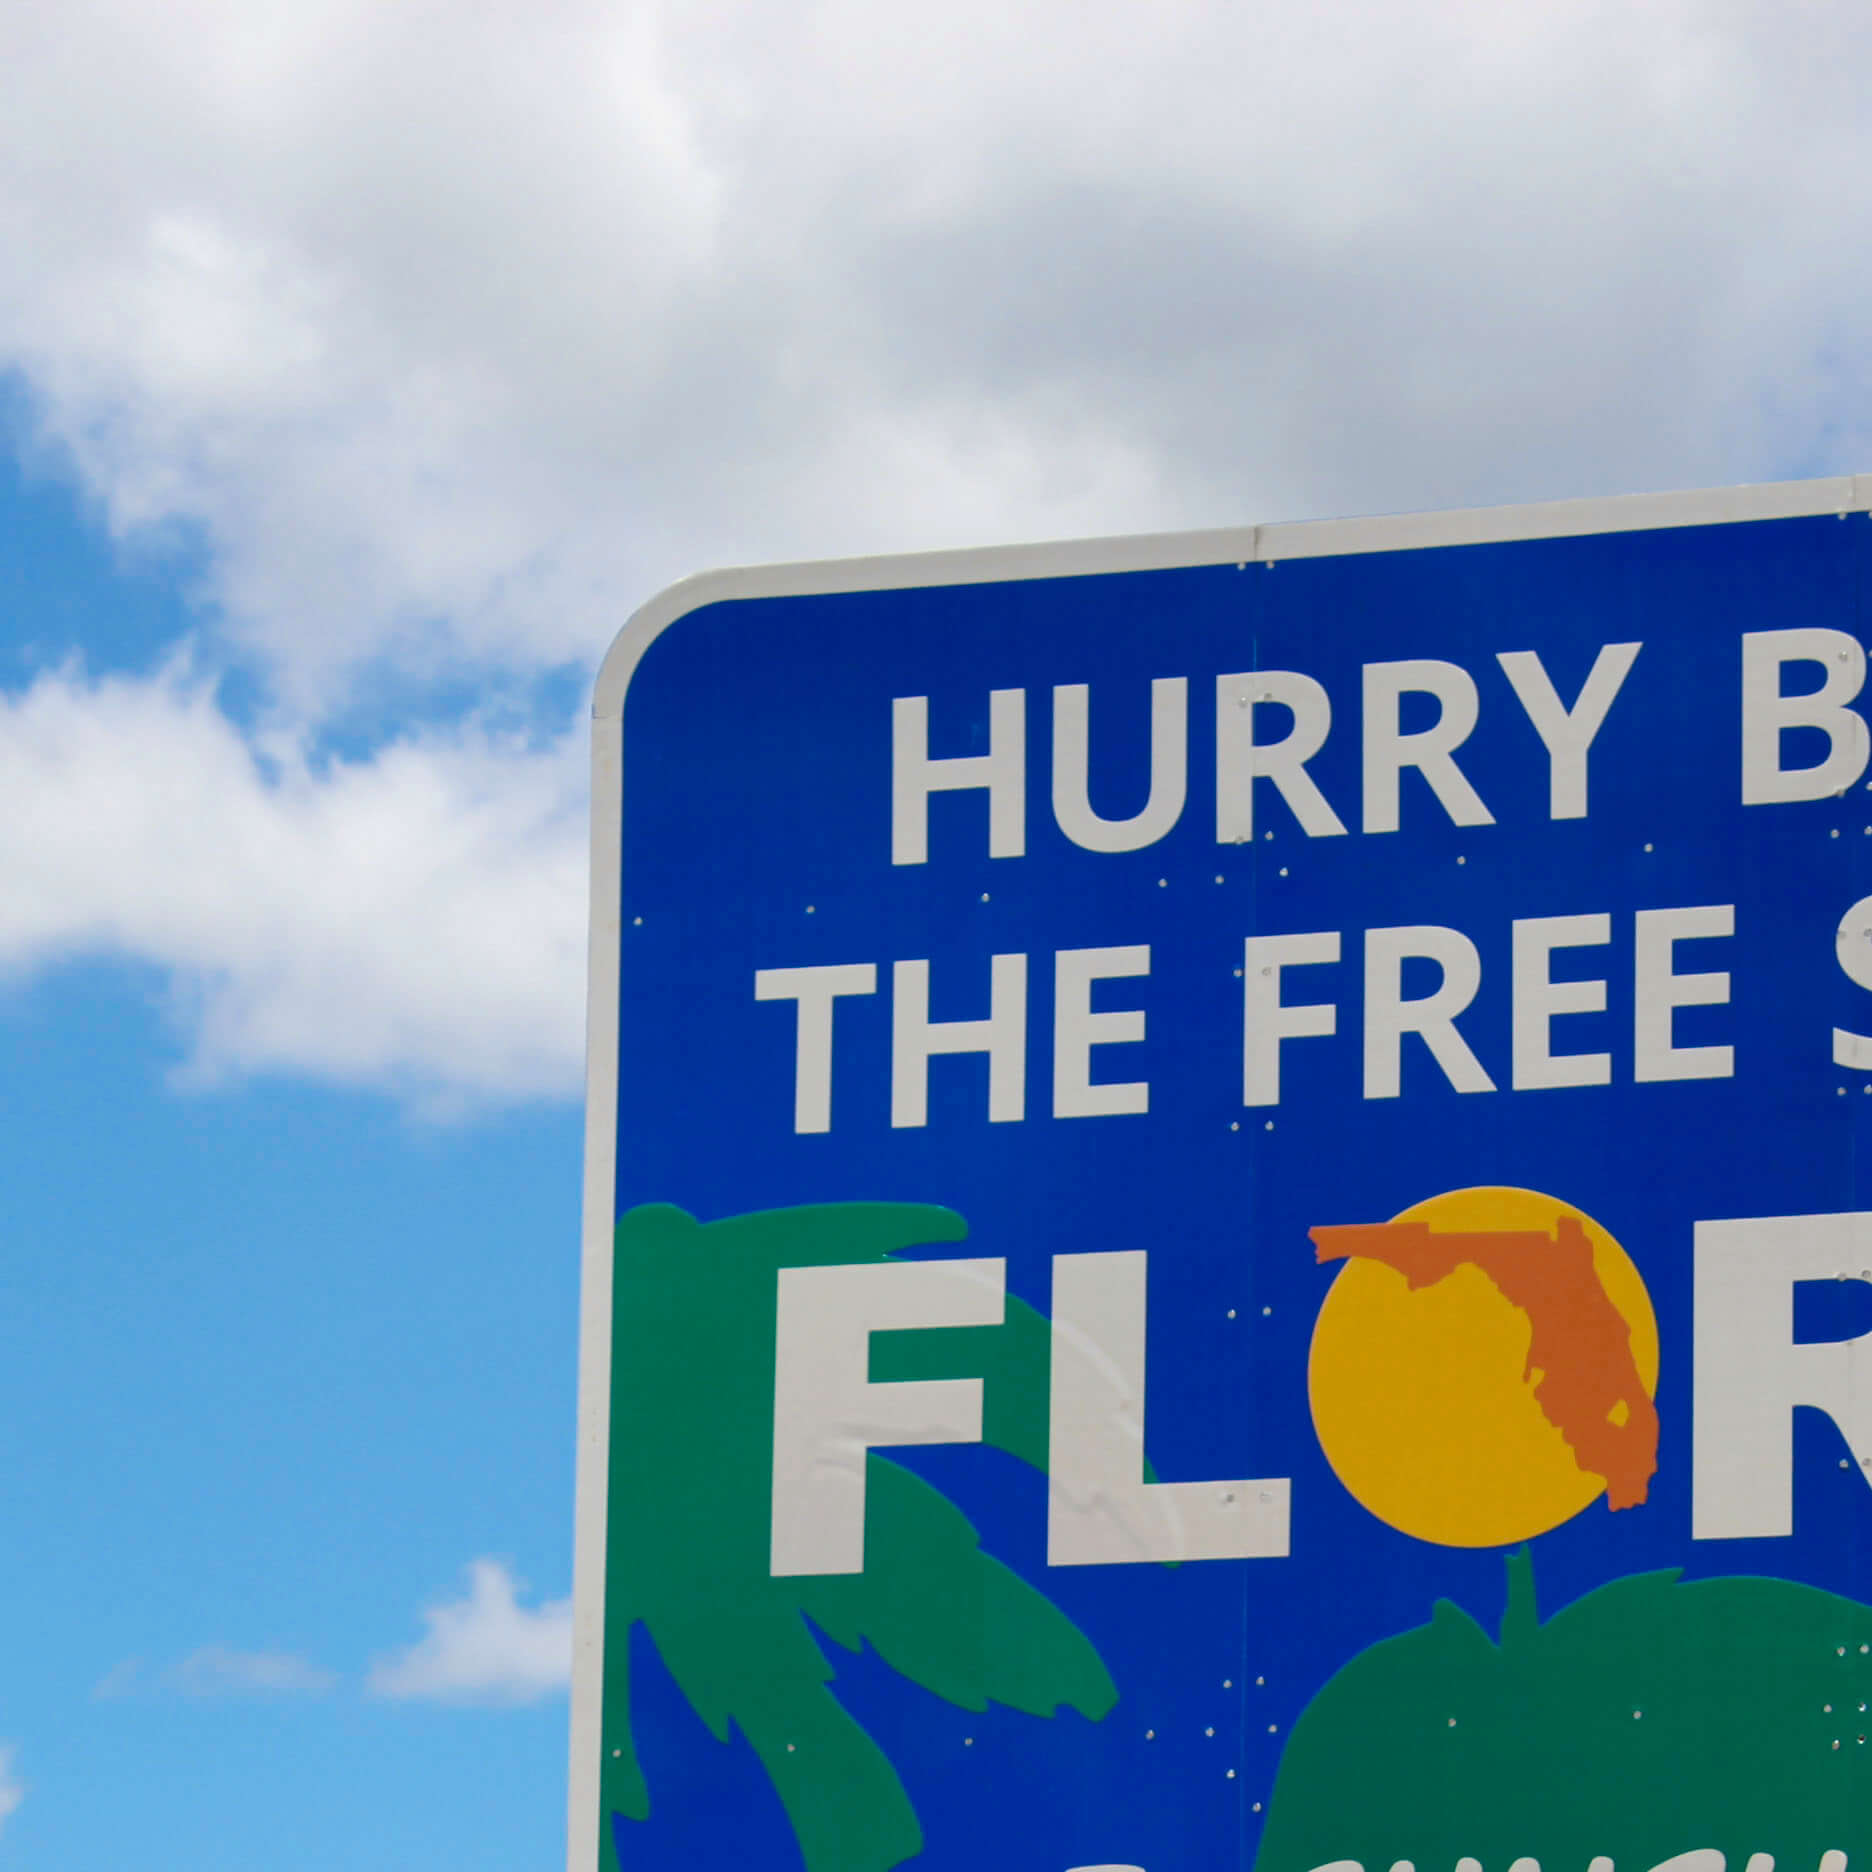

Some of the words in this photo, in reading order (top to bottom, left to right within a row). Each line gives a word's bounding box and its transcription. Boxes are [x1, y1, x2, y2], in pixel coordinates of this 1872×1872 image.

[891, 641, 1644, 867] HURRY
[754, 943, 1152, 1135] THE
[1243, 903, 1736, 1108] FREE
